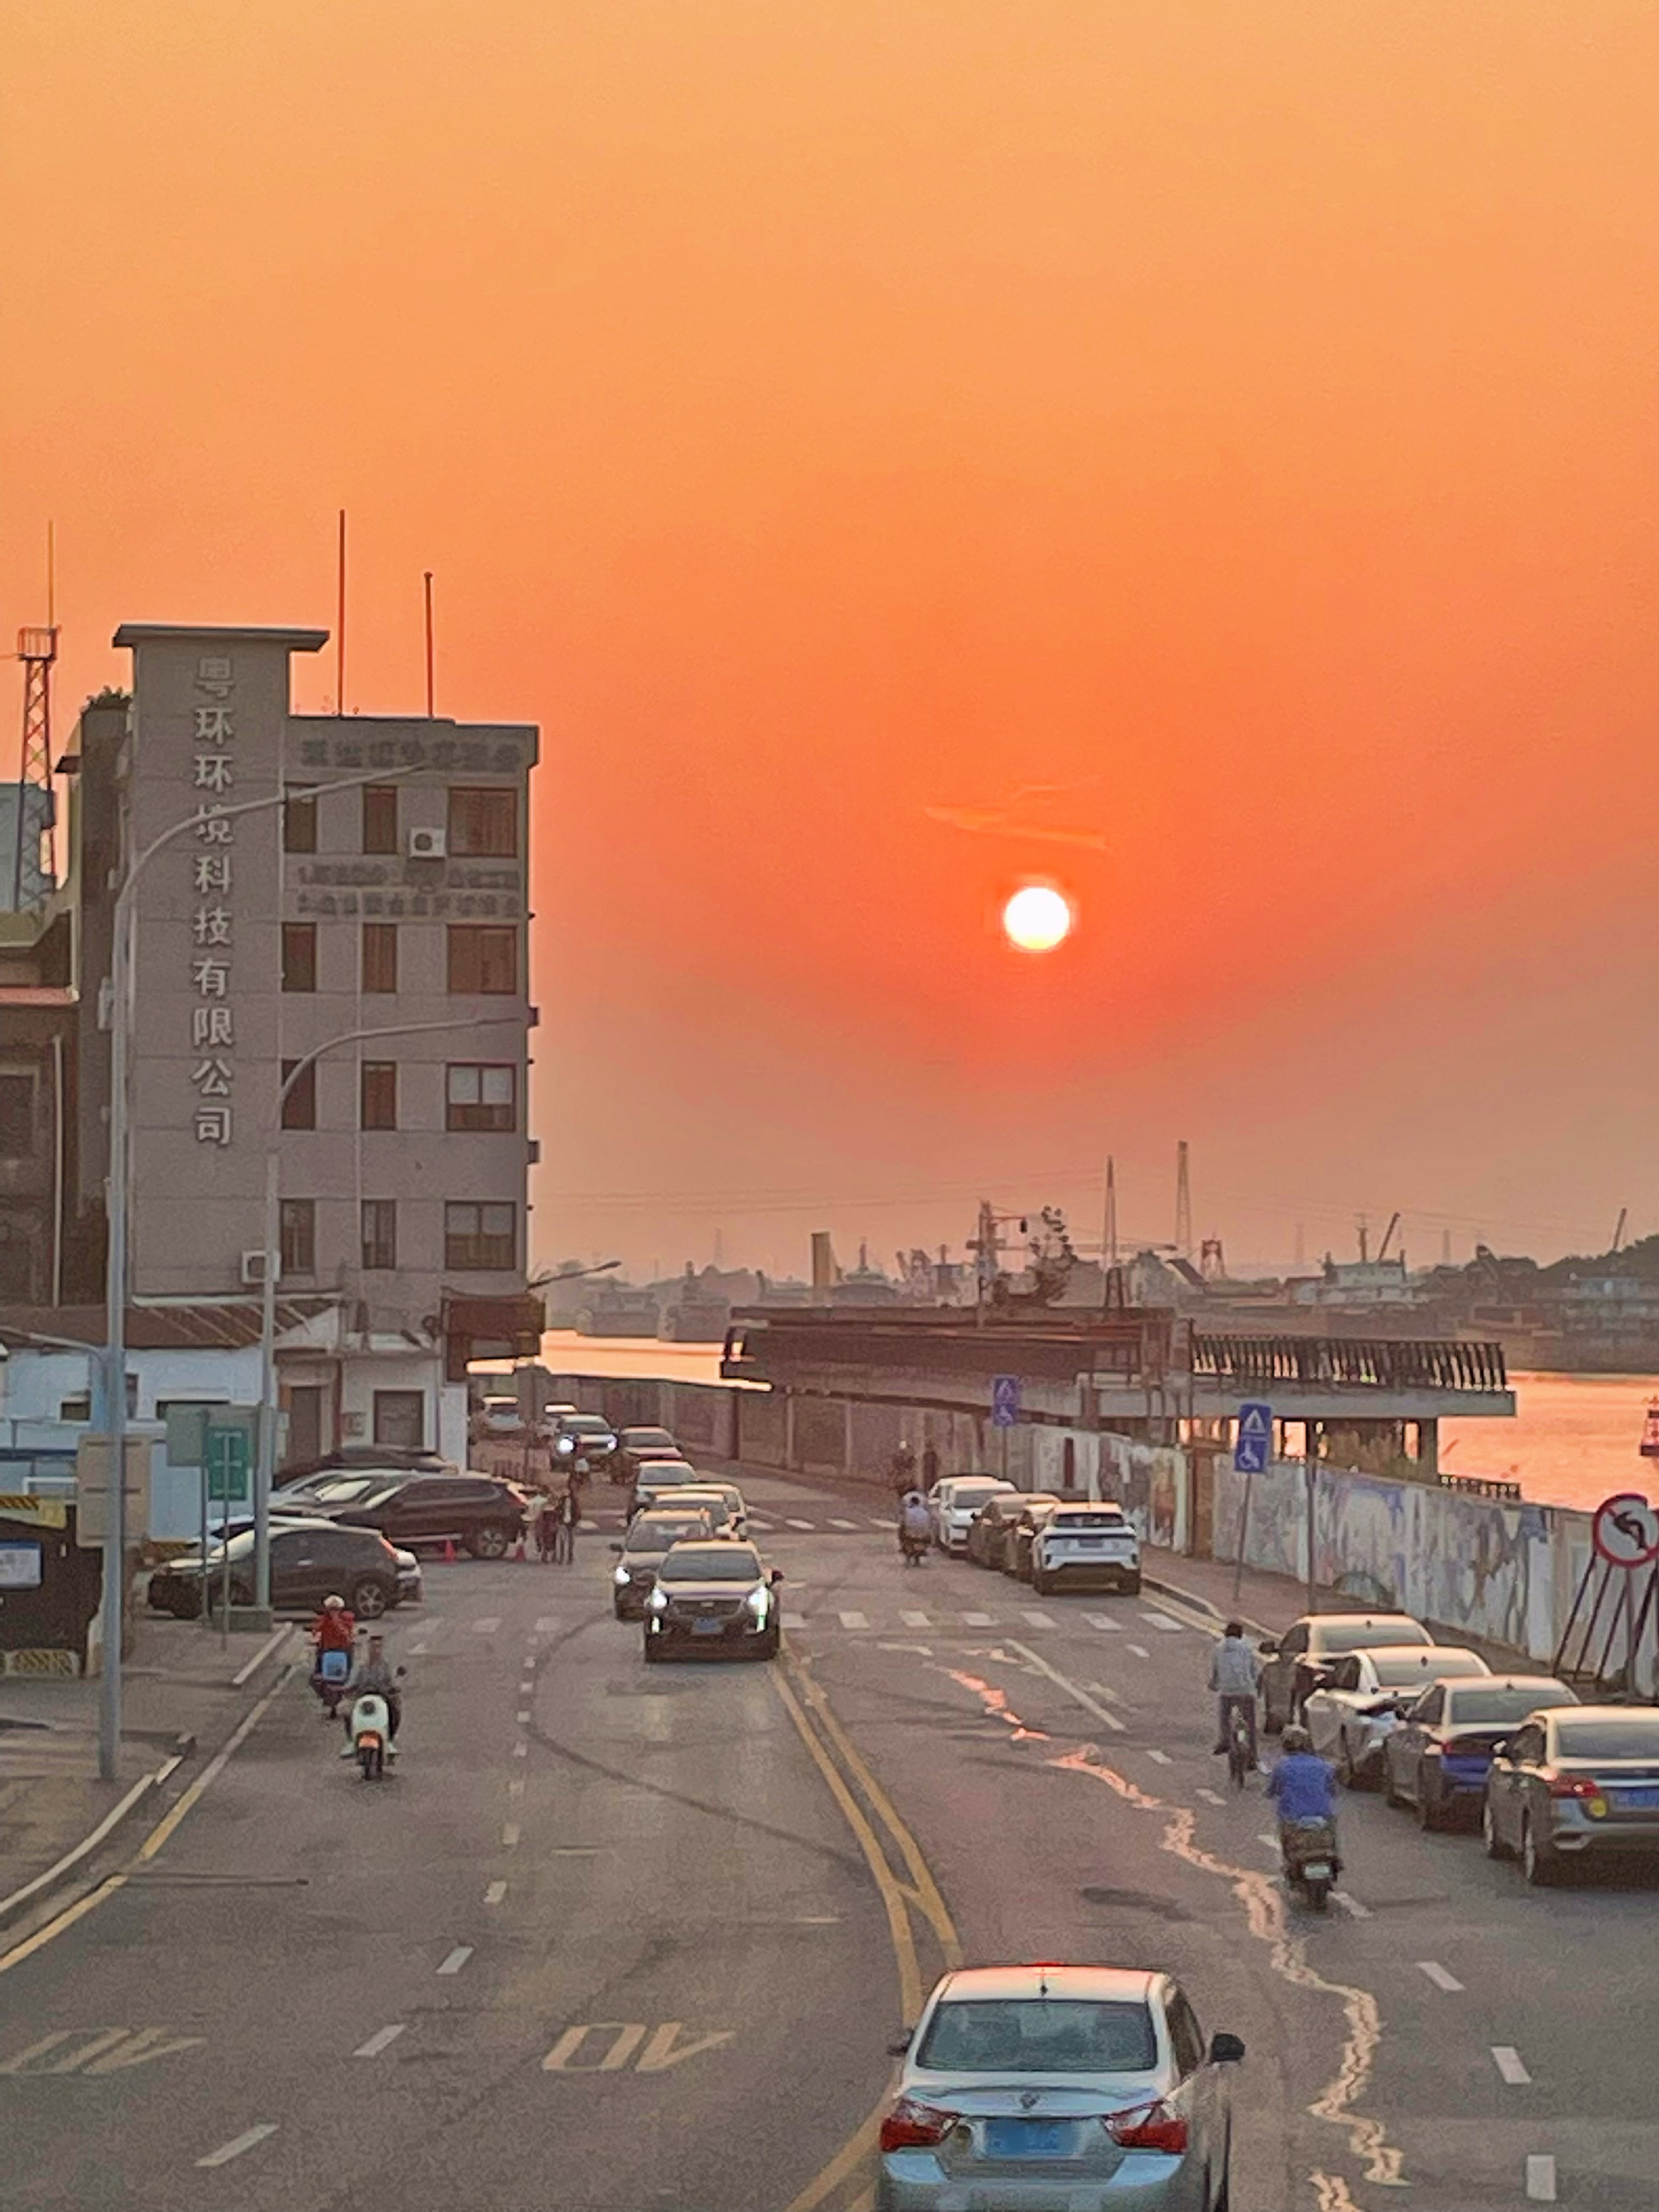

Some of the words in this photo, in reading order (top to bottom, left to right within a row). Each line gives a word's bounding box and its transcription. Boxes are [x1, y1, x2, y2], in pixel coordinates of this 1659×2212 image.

[192, 657, 233, 1146] 粤环环境科技有限公司
